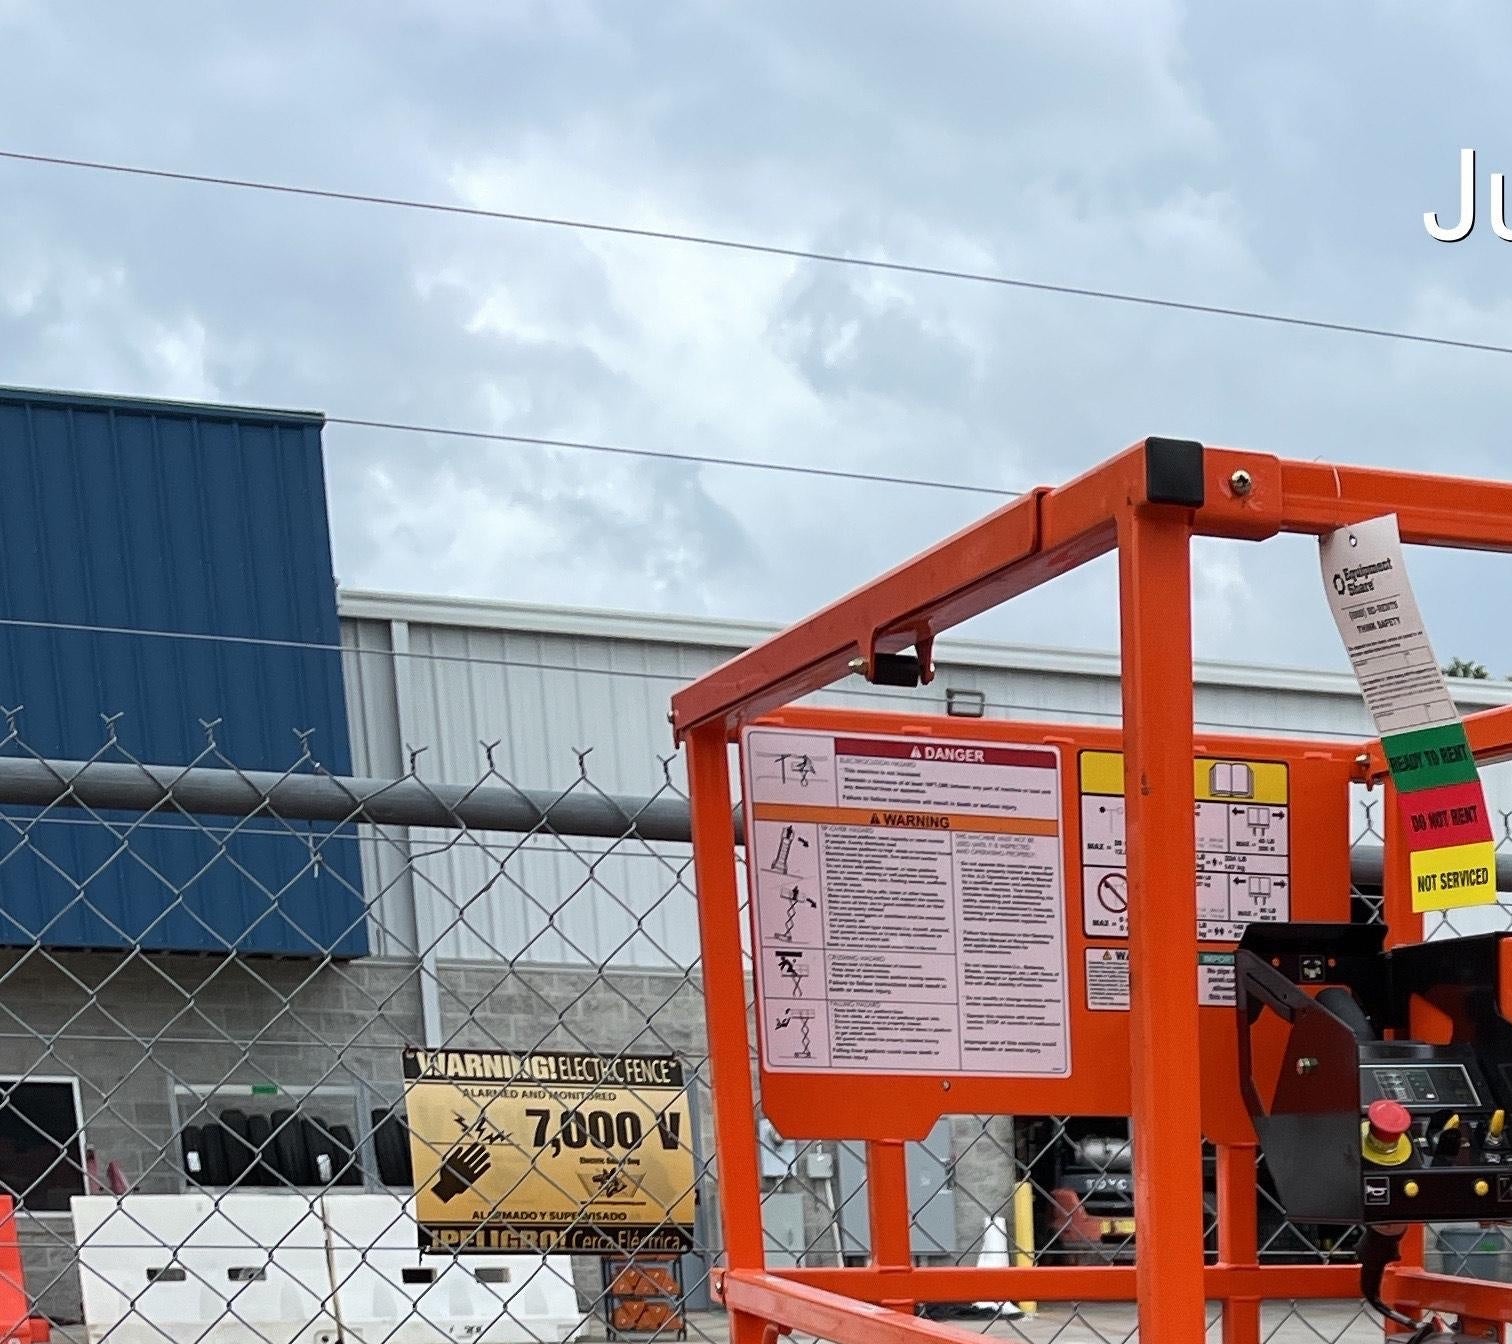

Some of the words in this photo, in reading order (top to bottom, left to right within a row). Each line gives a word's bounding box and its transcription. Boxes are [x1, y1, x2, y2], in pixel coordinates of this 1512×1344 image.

[1343, 558, 1392, 582] Equipment
[1347, 579, 1375, 597] Share
[925, 746, 985, 763] DANGER
[1424, 749, 1440, 768] TO
[1439, 743, 1468, 765] RENT
[883, 812, 950, 829] WARNING
[1411, 814, 1426, 832] DO
[1428, 810, 1449, 831] NOT
[1450, 804, 1478, 826] RENT
[1417, 873, 1438, 893] NOT
[1440, 867, 1489, 890] SERVICED
[416, 1052, 557, 1080] WARNING!
[558, 1056, 624, 1082] ELECTRC
[624, 1059, 671, 1083] FENCE
[521, 1089, 546, 1100] AND
[525, 1108, 642, 1158] 7,000
[658, 1112, 681, 1150] V
[472, 1210, 537, 1221] ALAMADO
[539, 1211, 547, 1220] Y
[549, 1211, 628, 1221] SUPEVISADO
[571, 1230, 616, 1250] Cerca
